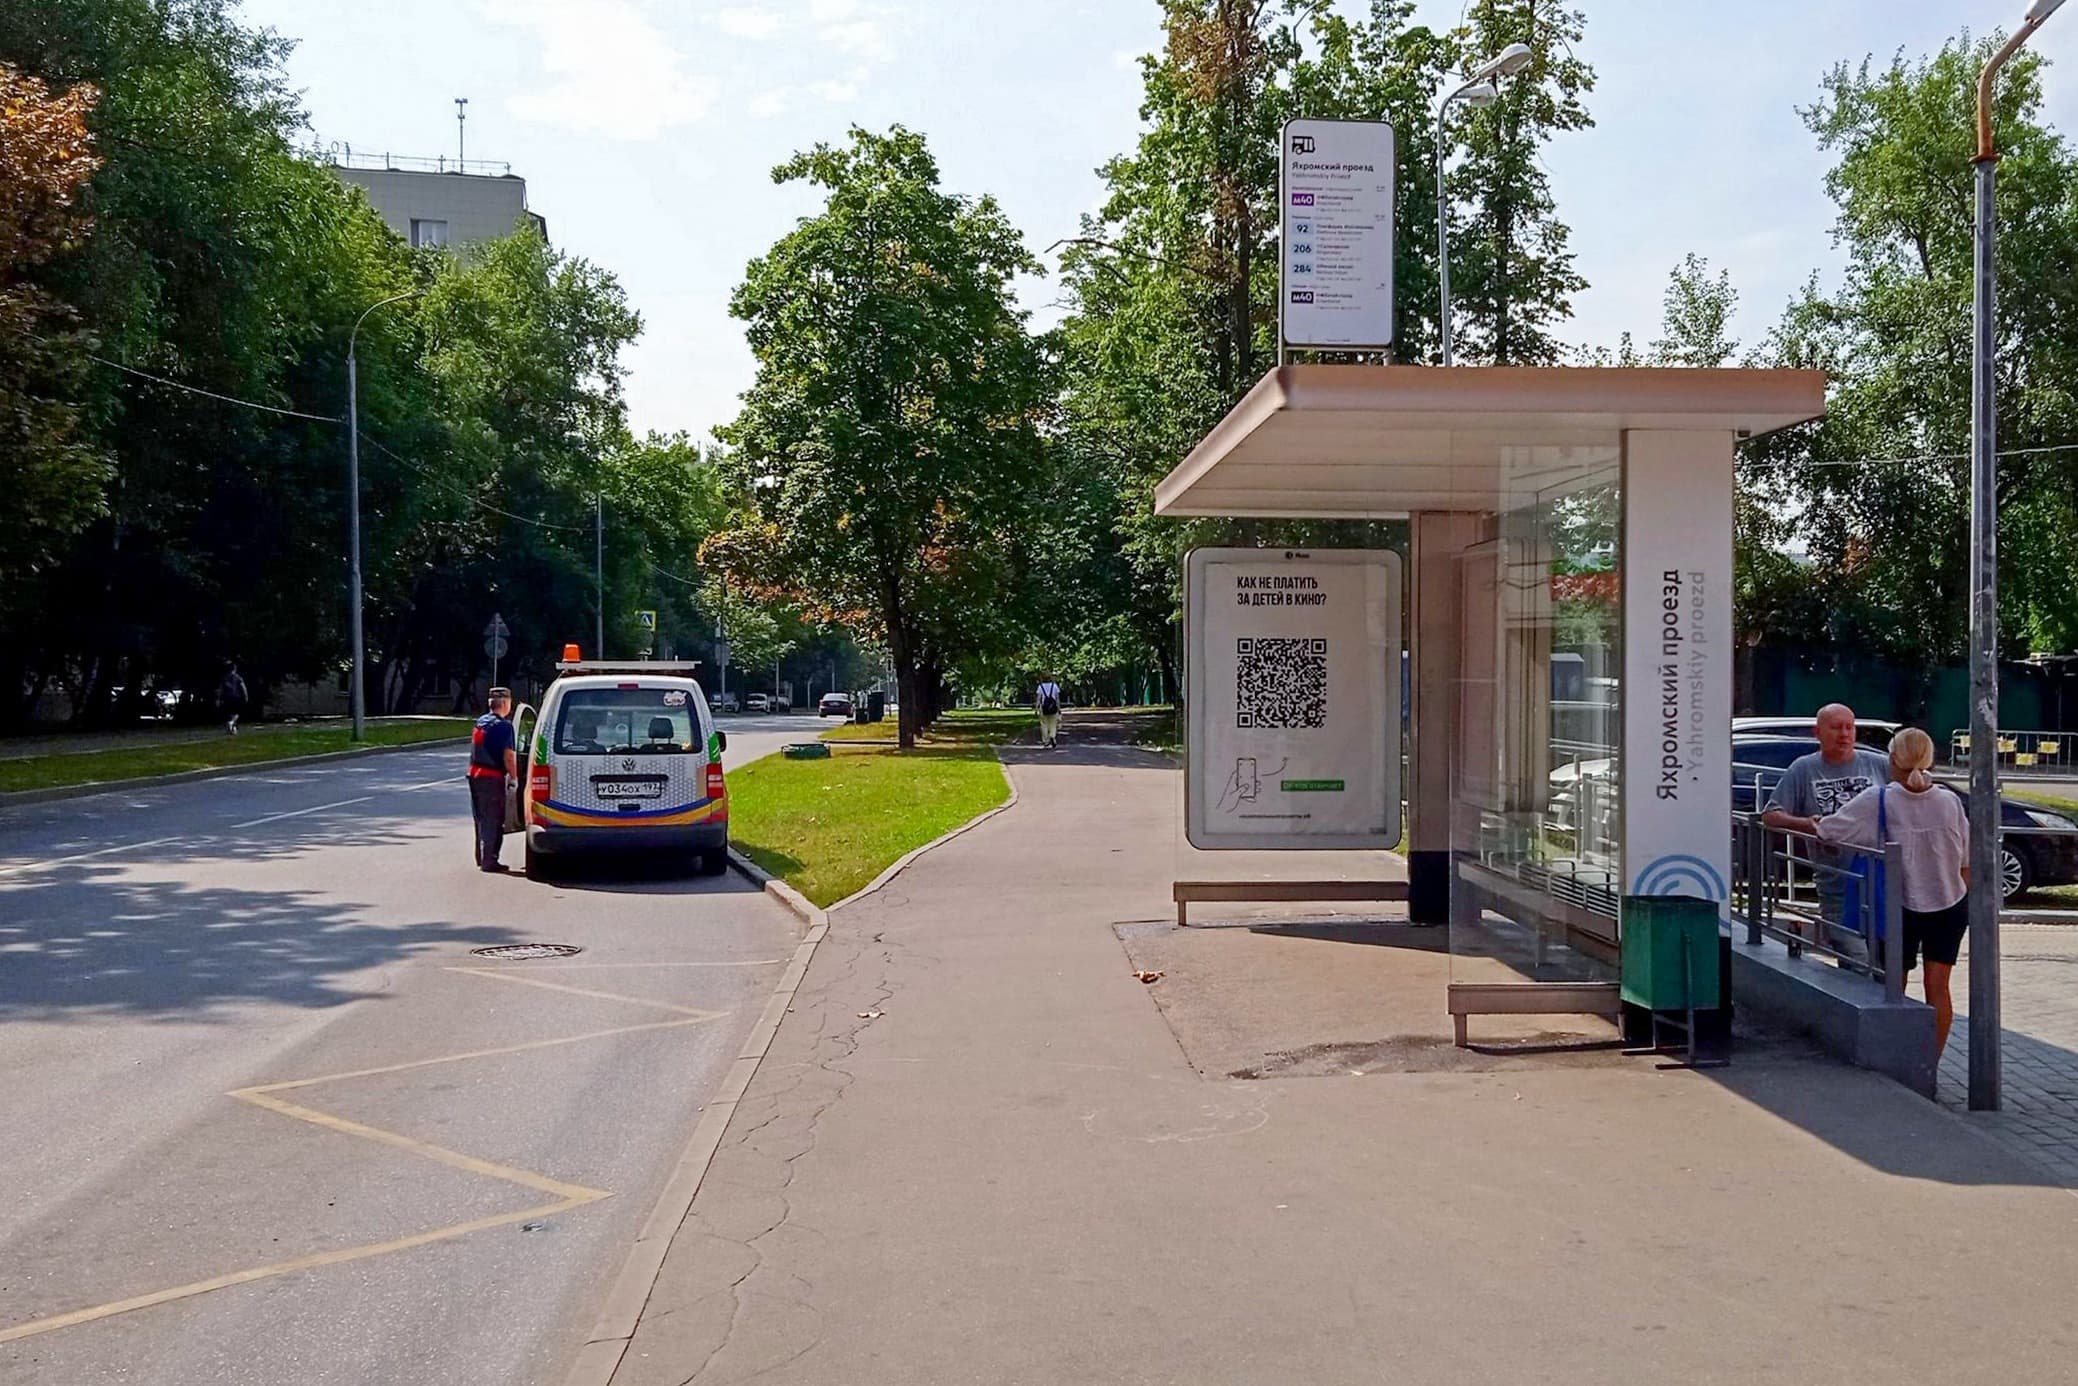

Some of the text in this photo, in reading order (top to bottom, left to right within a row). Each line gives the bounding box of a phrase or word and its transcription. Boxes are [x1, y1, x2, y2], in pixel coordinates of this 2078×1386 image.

[1292, 161, 1374, 172] Яхромский проезд
[1296, 224, 1308, 233] 92
[1293, 245, 1312, 253] 206
[1293, 264, 1312, 273] 284
[1237, 576, 1318, 589] КАК НЕ ПЛАТИТЬ
[1237, 591, 1327, 607] ЗА ДЕТЕЙ В КИНО?
[1686, 572, 1708, 772] Yahromskiy proezd
[1656, 569, 1683, 800] Яхромский проезд
